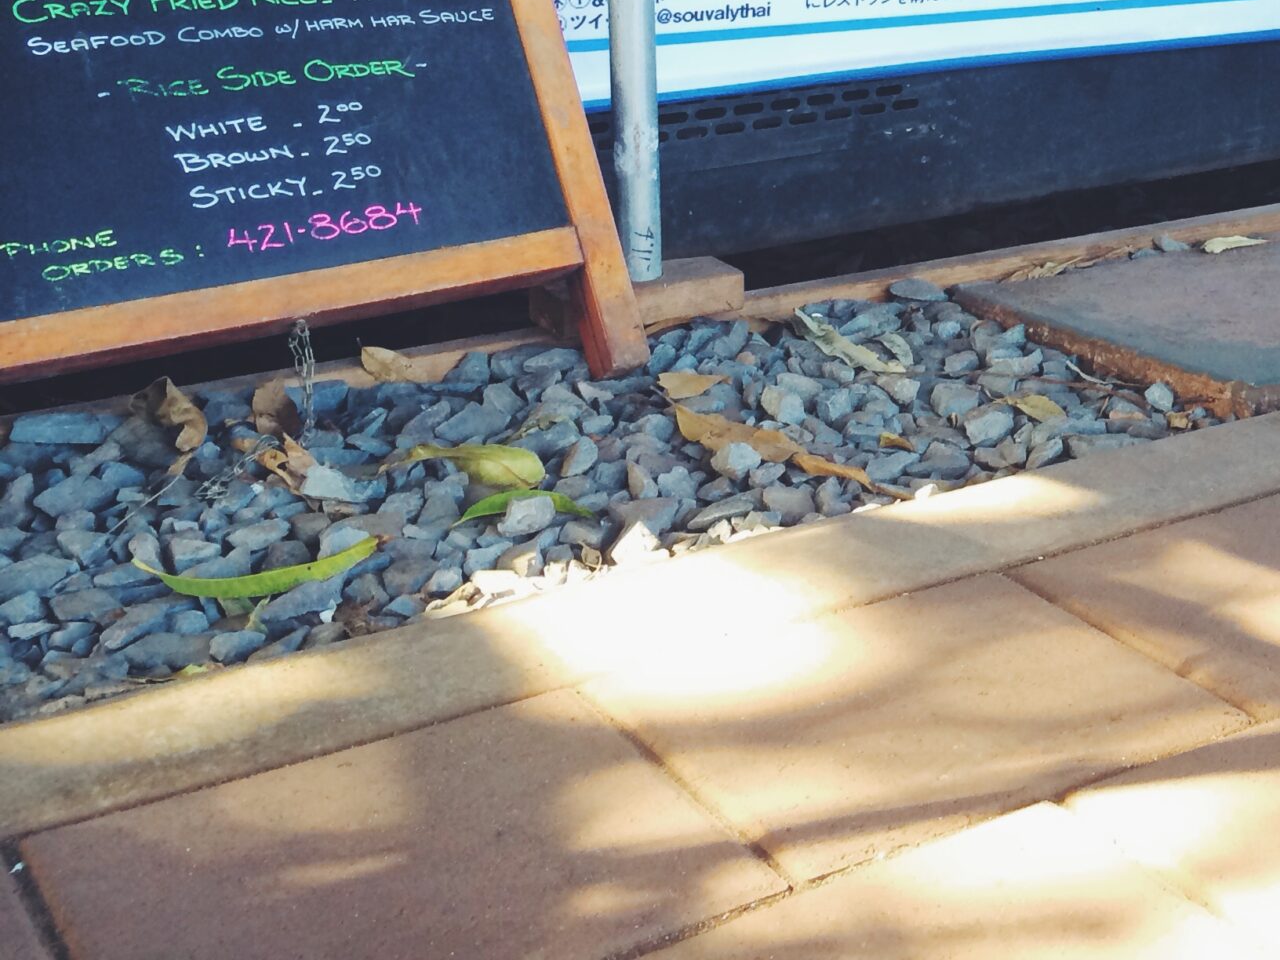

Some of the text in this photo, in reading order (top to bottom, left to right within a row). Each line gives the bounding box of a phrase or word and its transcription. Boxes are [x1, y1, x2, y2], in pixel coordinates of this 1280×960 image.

[657, 2, 771, 24] @souvalythai
[26, 29, 166, 57] SEAFOOD
[176, 24, 264, 43] COMBO
[304, 15, 364, 33] HARM
[369, 11, 416, 28] HAR
[421, 6, 495, 25] SAUCE
[116, 57, 416, 101] RICE SIDE ORDER
[165, 113, 268, 143] WHITE
[173, 143, 294, 175] BROWN
[189, 174, 312, 210] STICKY
[0, 228, 117, 259] PHONE
[227, 201, 423, 253] 421-8684
